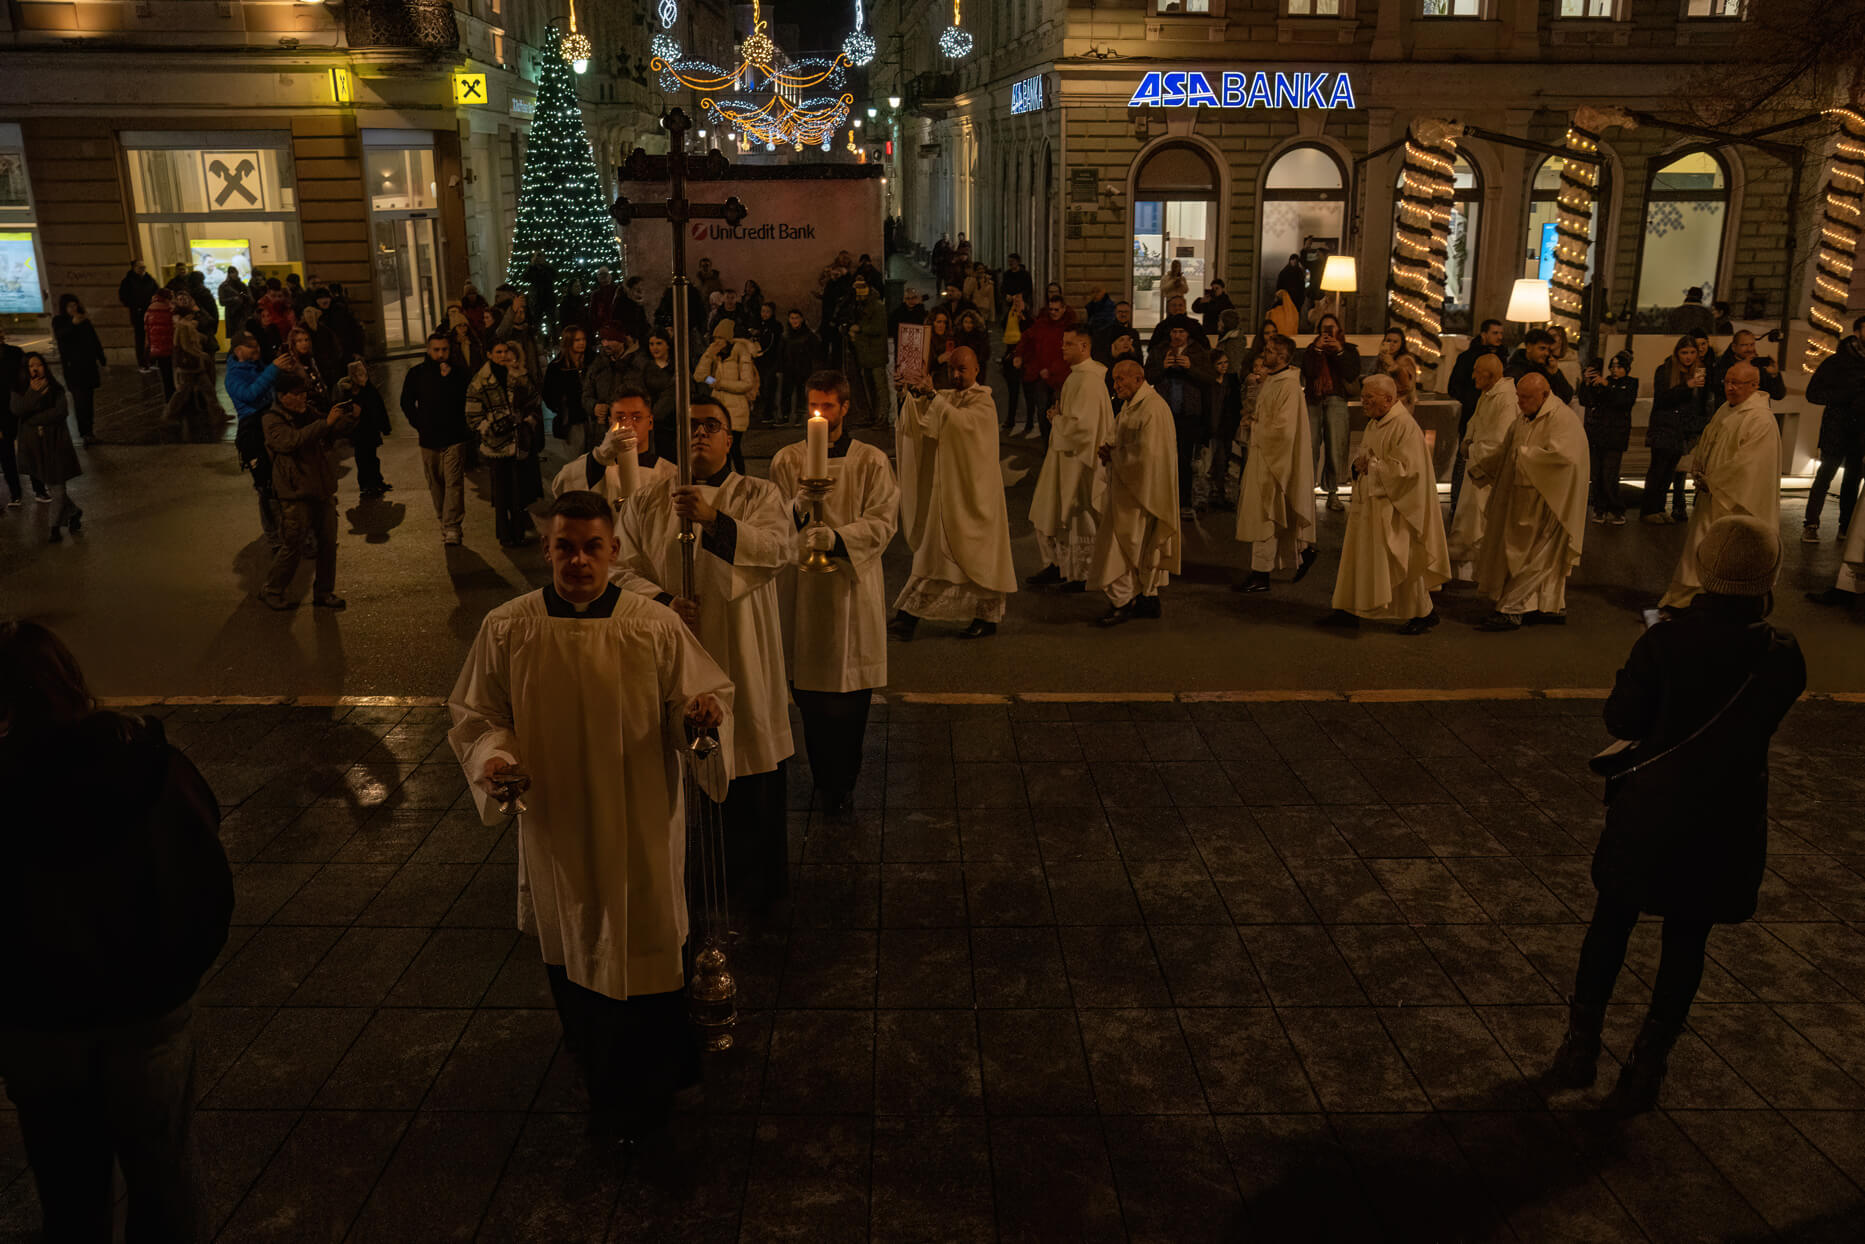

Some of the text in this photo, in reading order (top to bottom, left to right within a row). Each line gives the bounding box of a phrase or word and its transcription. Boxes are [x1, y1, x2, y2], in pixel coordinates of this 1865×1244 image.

[1023, 73, 1044, 112] BANKA
[1127, 71, 1356, 109] ASA BANKA
[709, 223, 816, 240] UniCredit Bank
